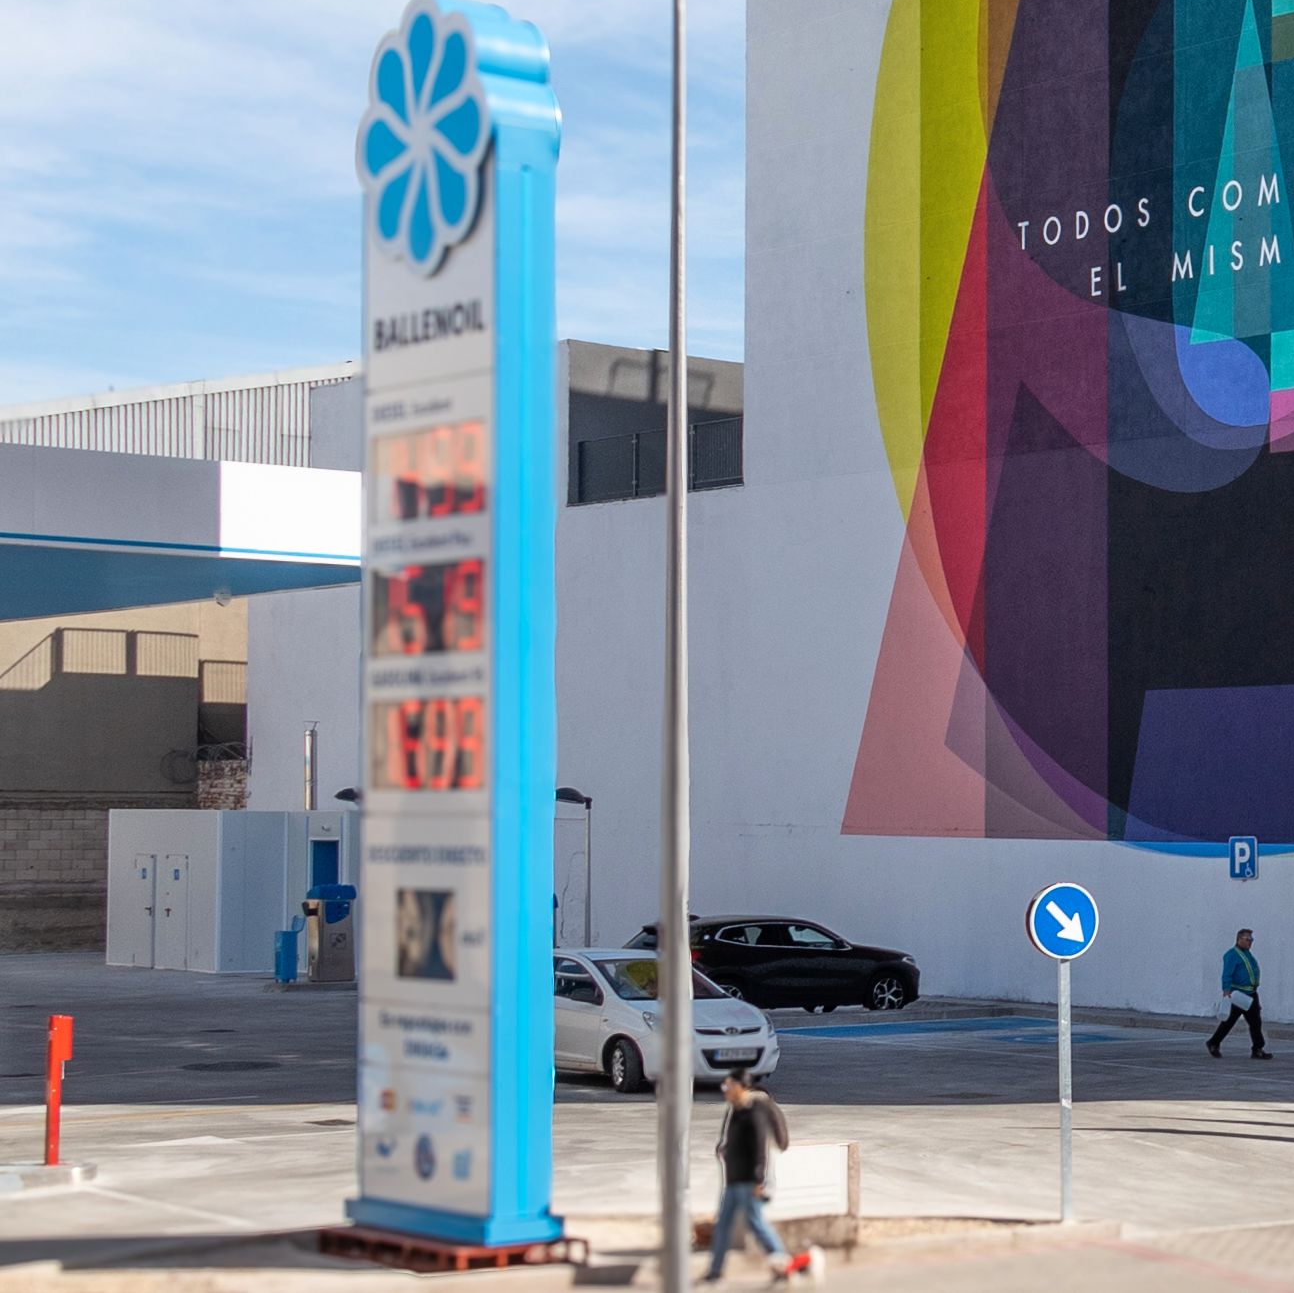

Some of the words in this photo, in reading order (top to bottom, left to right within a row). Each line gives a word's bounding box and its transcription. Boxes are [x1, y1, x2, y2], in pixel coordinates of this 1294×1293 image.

[1018, 198, 1150, 250] TODOS
[1091, 262, 1126, 297] EL
[374, 298, 484, 352] BALLENOIL
[1235, 842, 1250, 874] P
